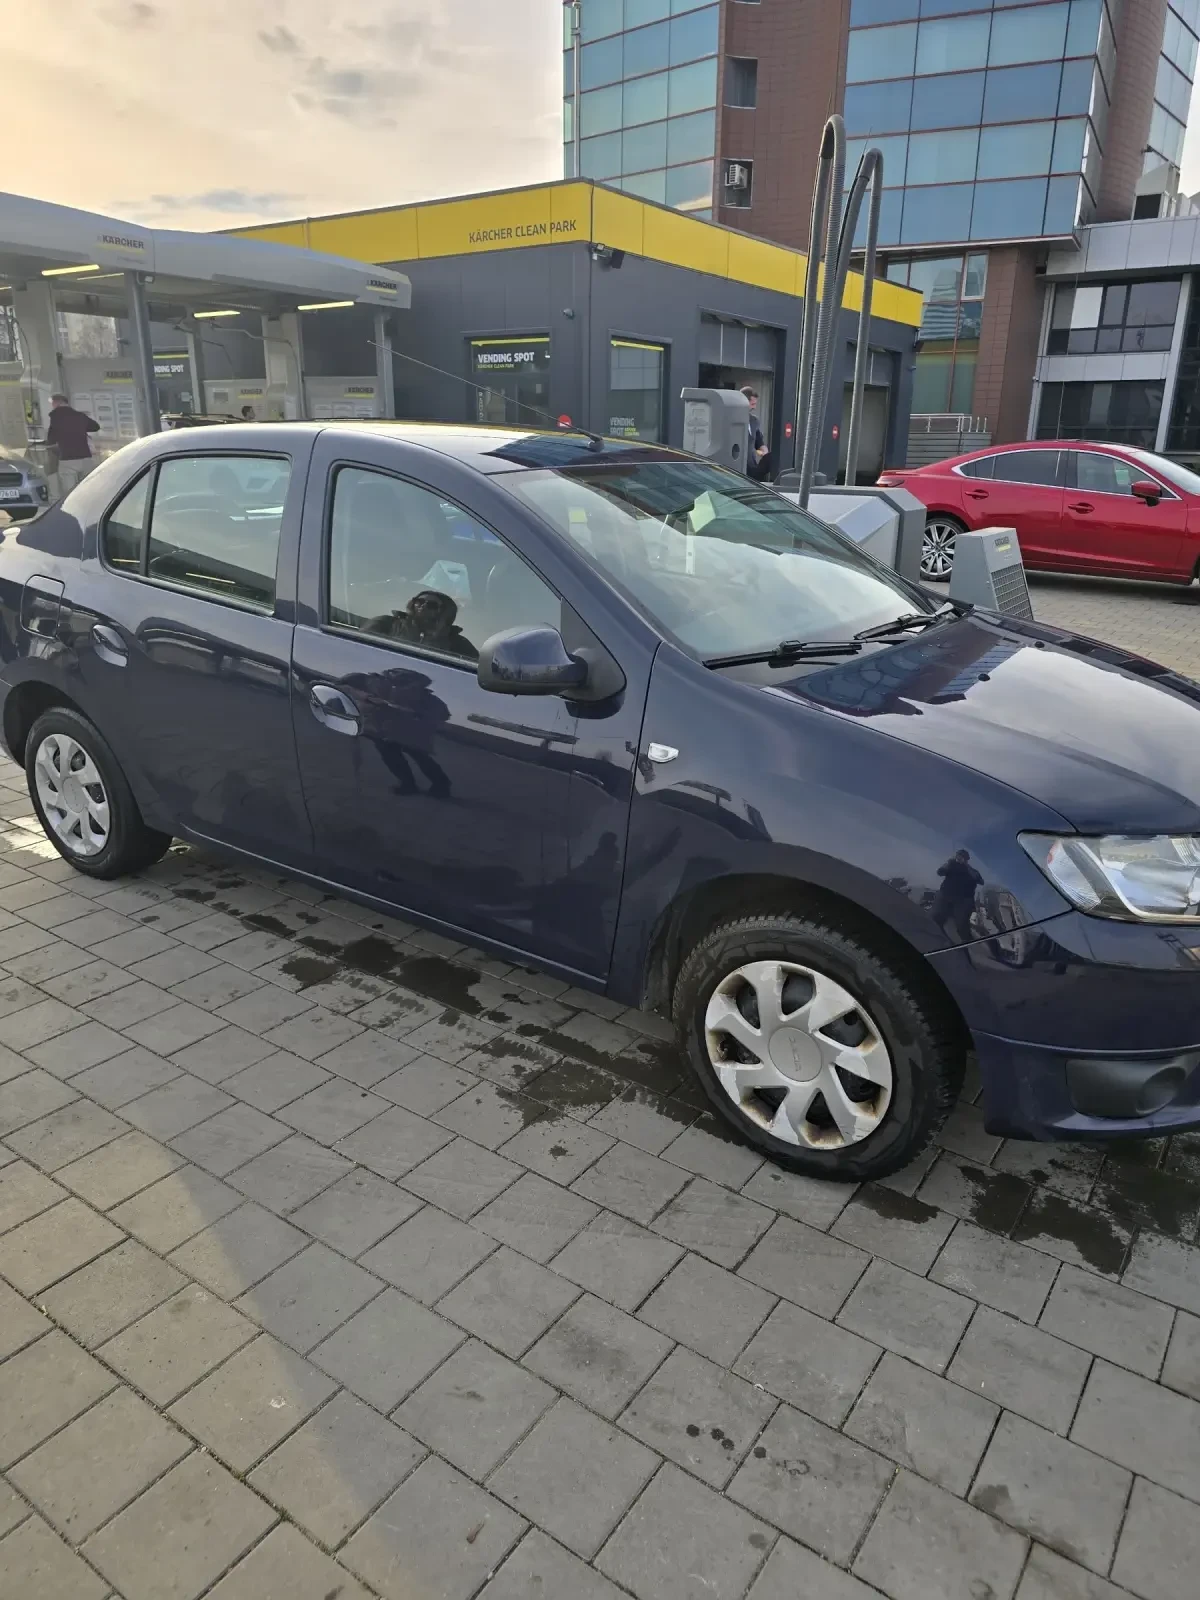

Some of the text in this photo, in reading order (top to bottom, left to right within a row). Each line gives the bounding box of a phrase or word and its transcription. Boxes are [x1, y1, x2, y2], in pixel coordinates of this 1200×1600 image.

[469, 219, 577, 244] KÄRCHER CLEAN PARK
[477, 351, 535, 363] VENDING SPOT
[154, 364, 184, 373] NDING SPOT
[610, 416, 635, 426] VENDING
